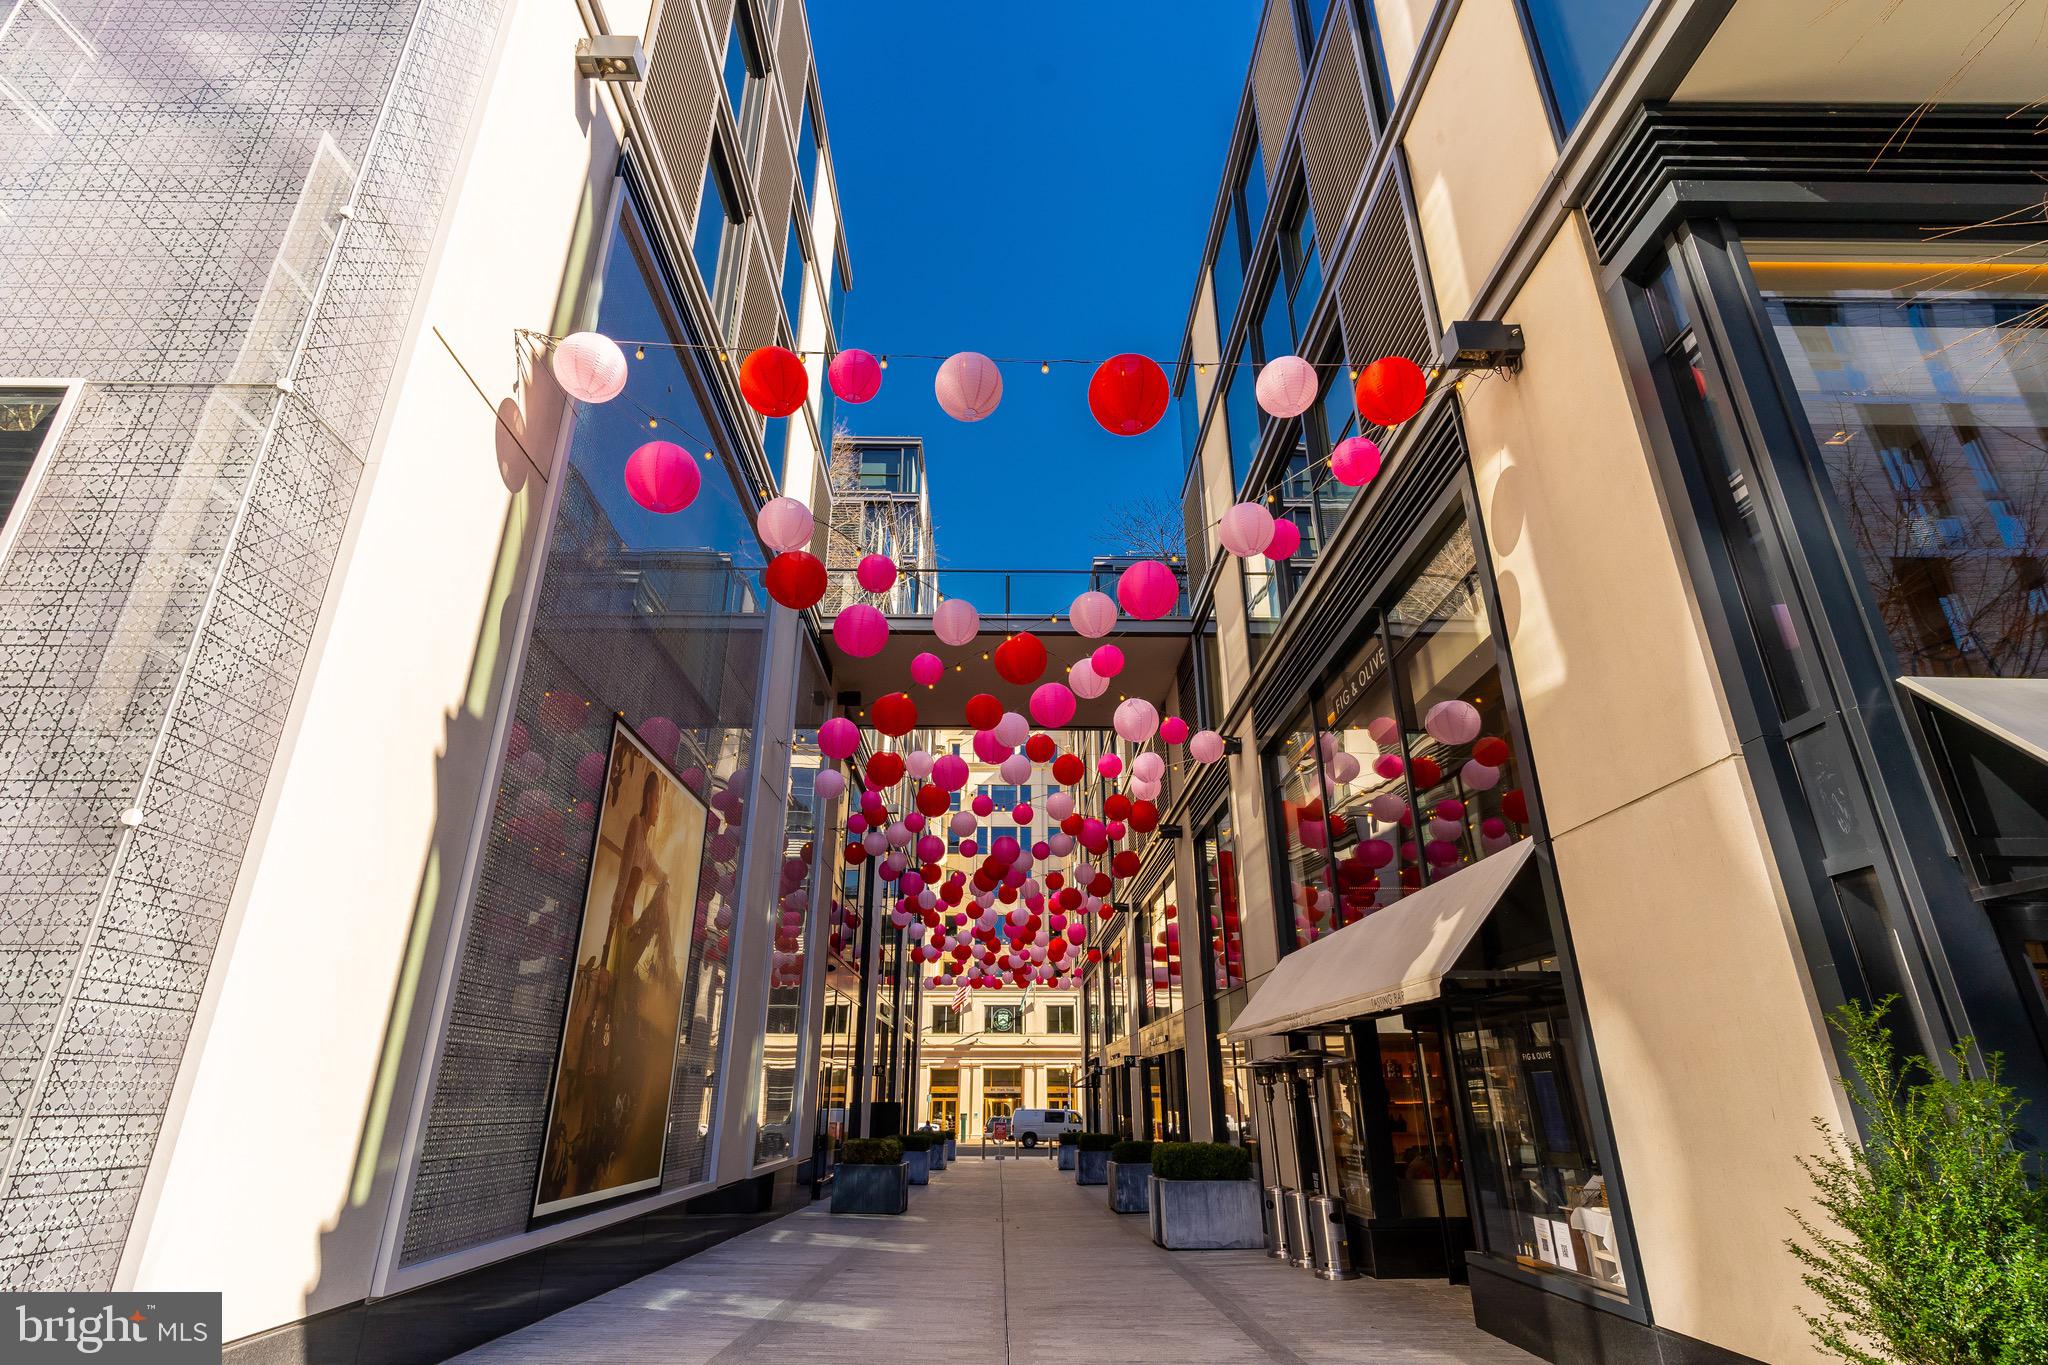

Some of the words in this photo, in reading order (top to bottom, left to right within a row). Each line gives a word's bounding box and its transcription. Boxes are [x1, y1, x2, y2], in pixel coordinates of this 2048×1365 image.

[1335, 689, 1350, 714] FIG
[1351, 682, 1358, 696] &
[1358, 647, 1386, 687] OLIVE
[1393, 990, 1405, 1004] BAR
[1522, 1053, 1531, 1061] FIG
[1536, 1051, 1552, 1060] OLIVE
